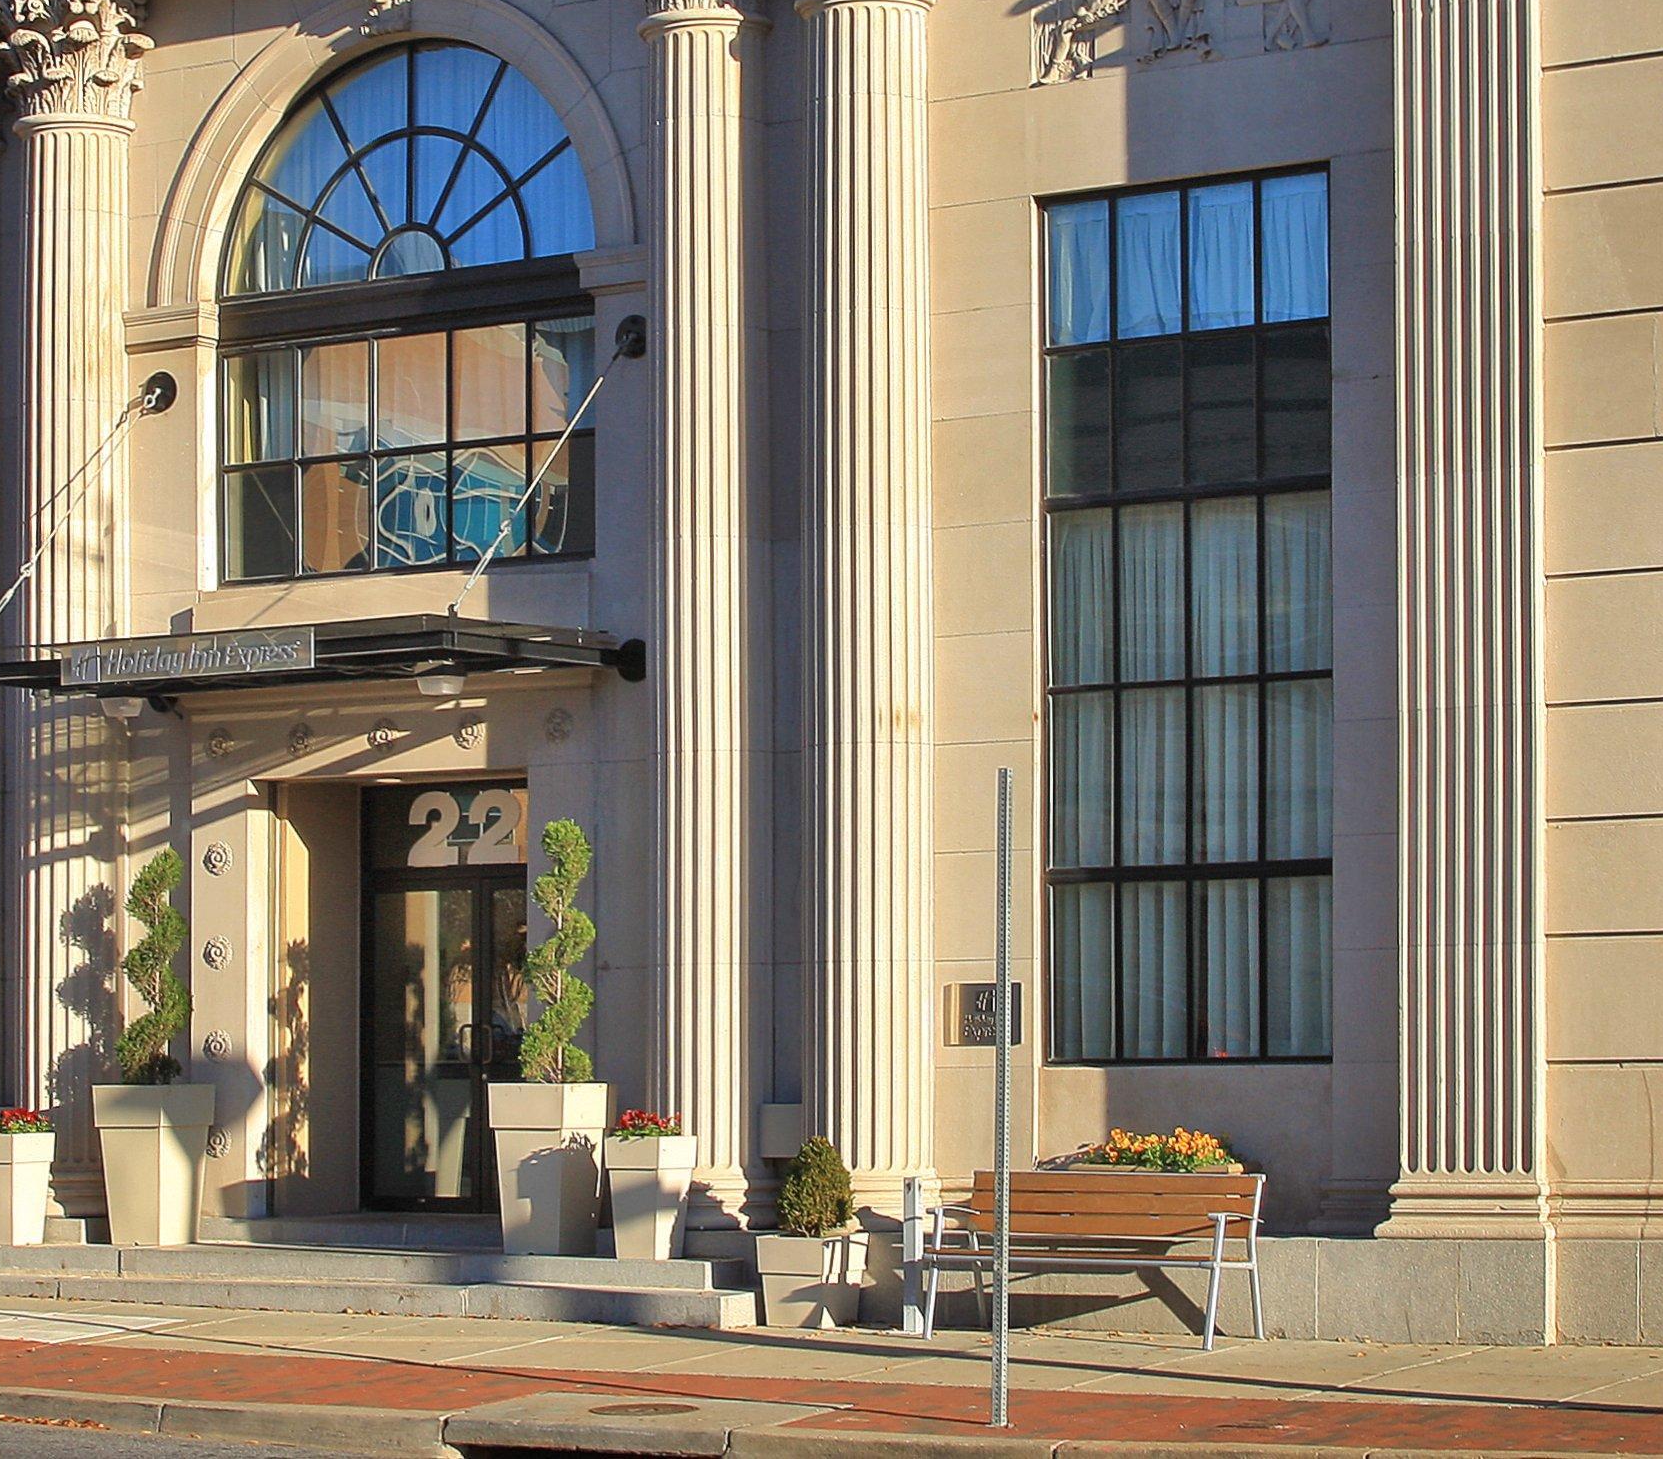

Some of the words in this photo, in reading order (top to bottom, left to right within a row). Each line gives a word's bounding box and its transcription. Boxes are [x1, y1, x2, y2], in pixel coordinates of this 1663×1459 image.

[107, 646, 186, 677] Holiday
[188, 641, 222, 670] Inn
[225, 641, 297, 673] Express
[407, 789, 522, 867] 22
